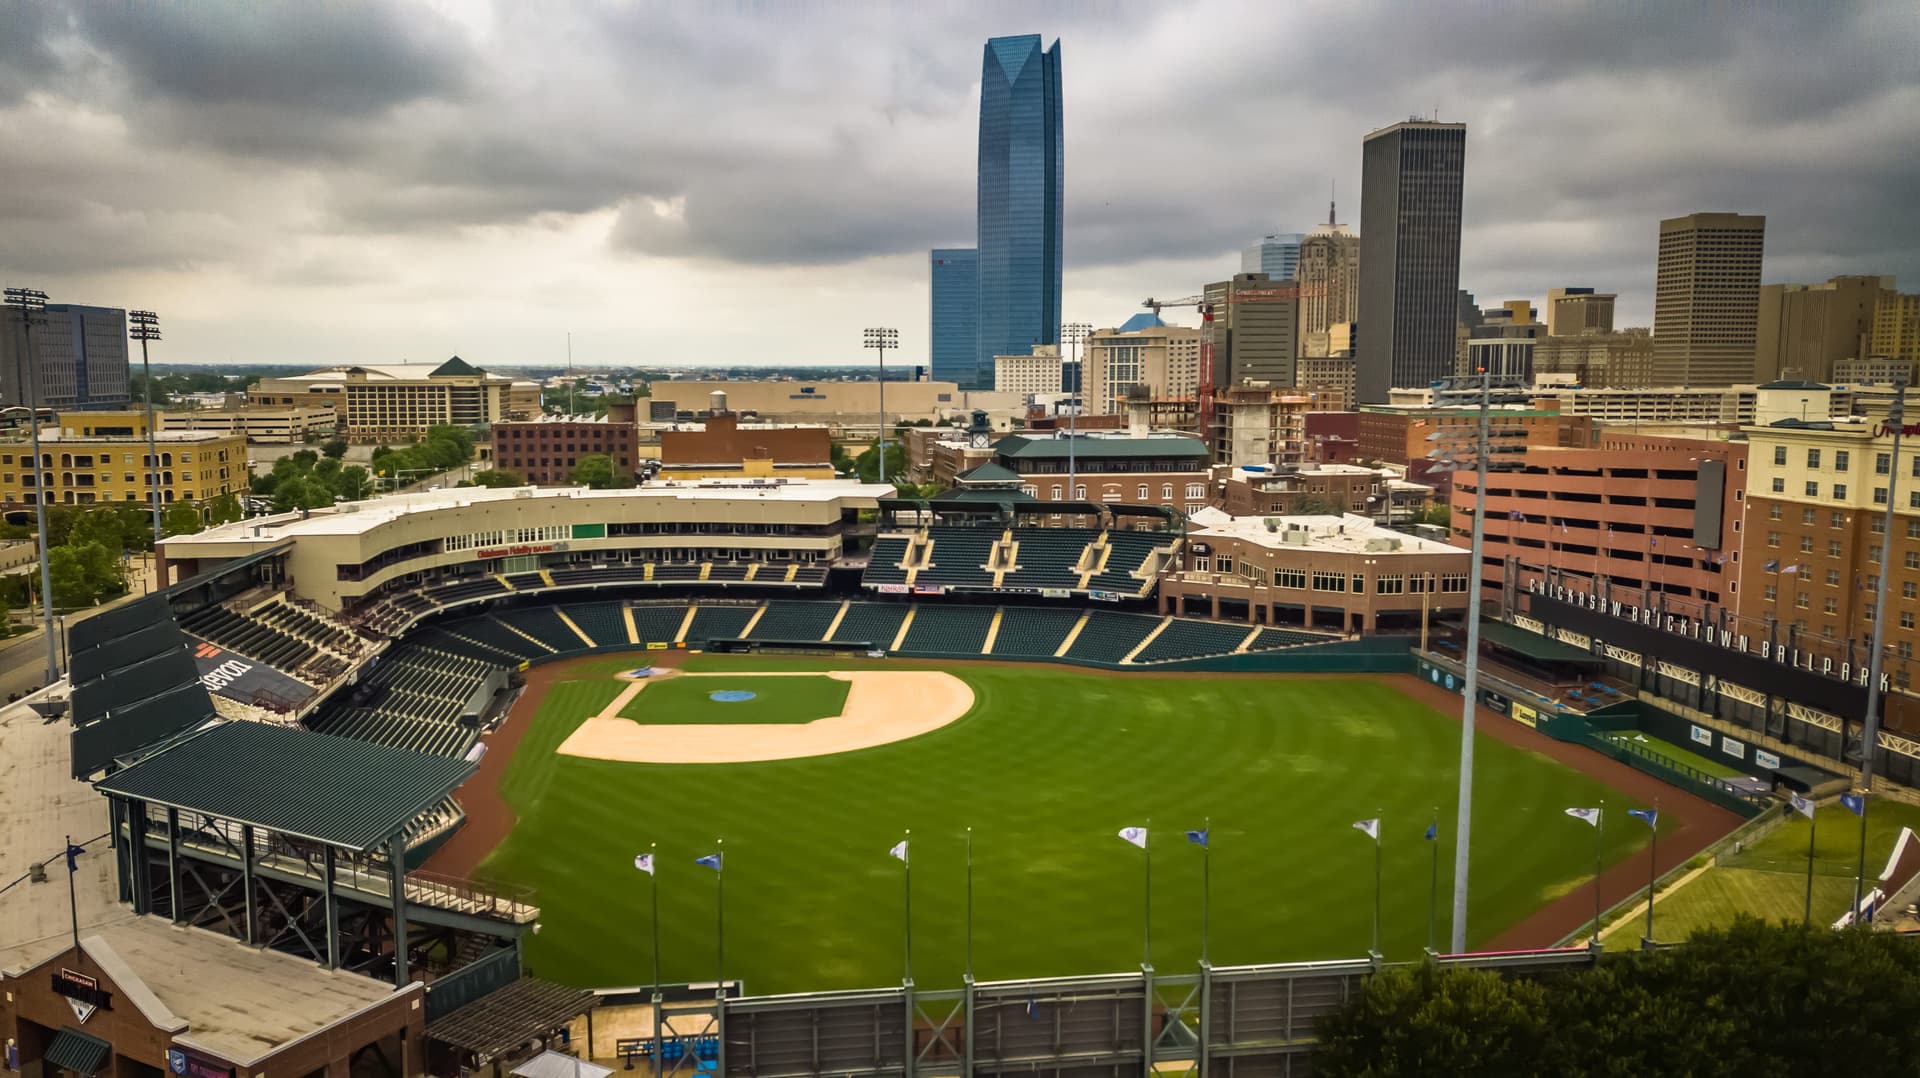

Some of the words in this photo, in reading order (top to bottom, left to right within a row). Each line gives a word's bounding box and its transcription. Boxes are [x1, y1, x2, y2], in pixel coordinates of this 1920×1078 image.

[1529, 578, 1622, 617] CHICKASAW
[1631, 606, 1748, 653] BRICKTOWN
[1762, 640, 1889, 693] BALLPARK
